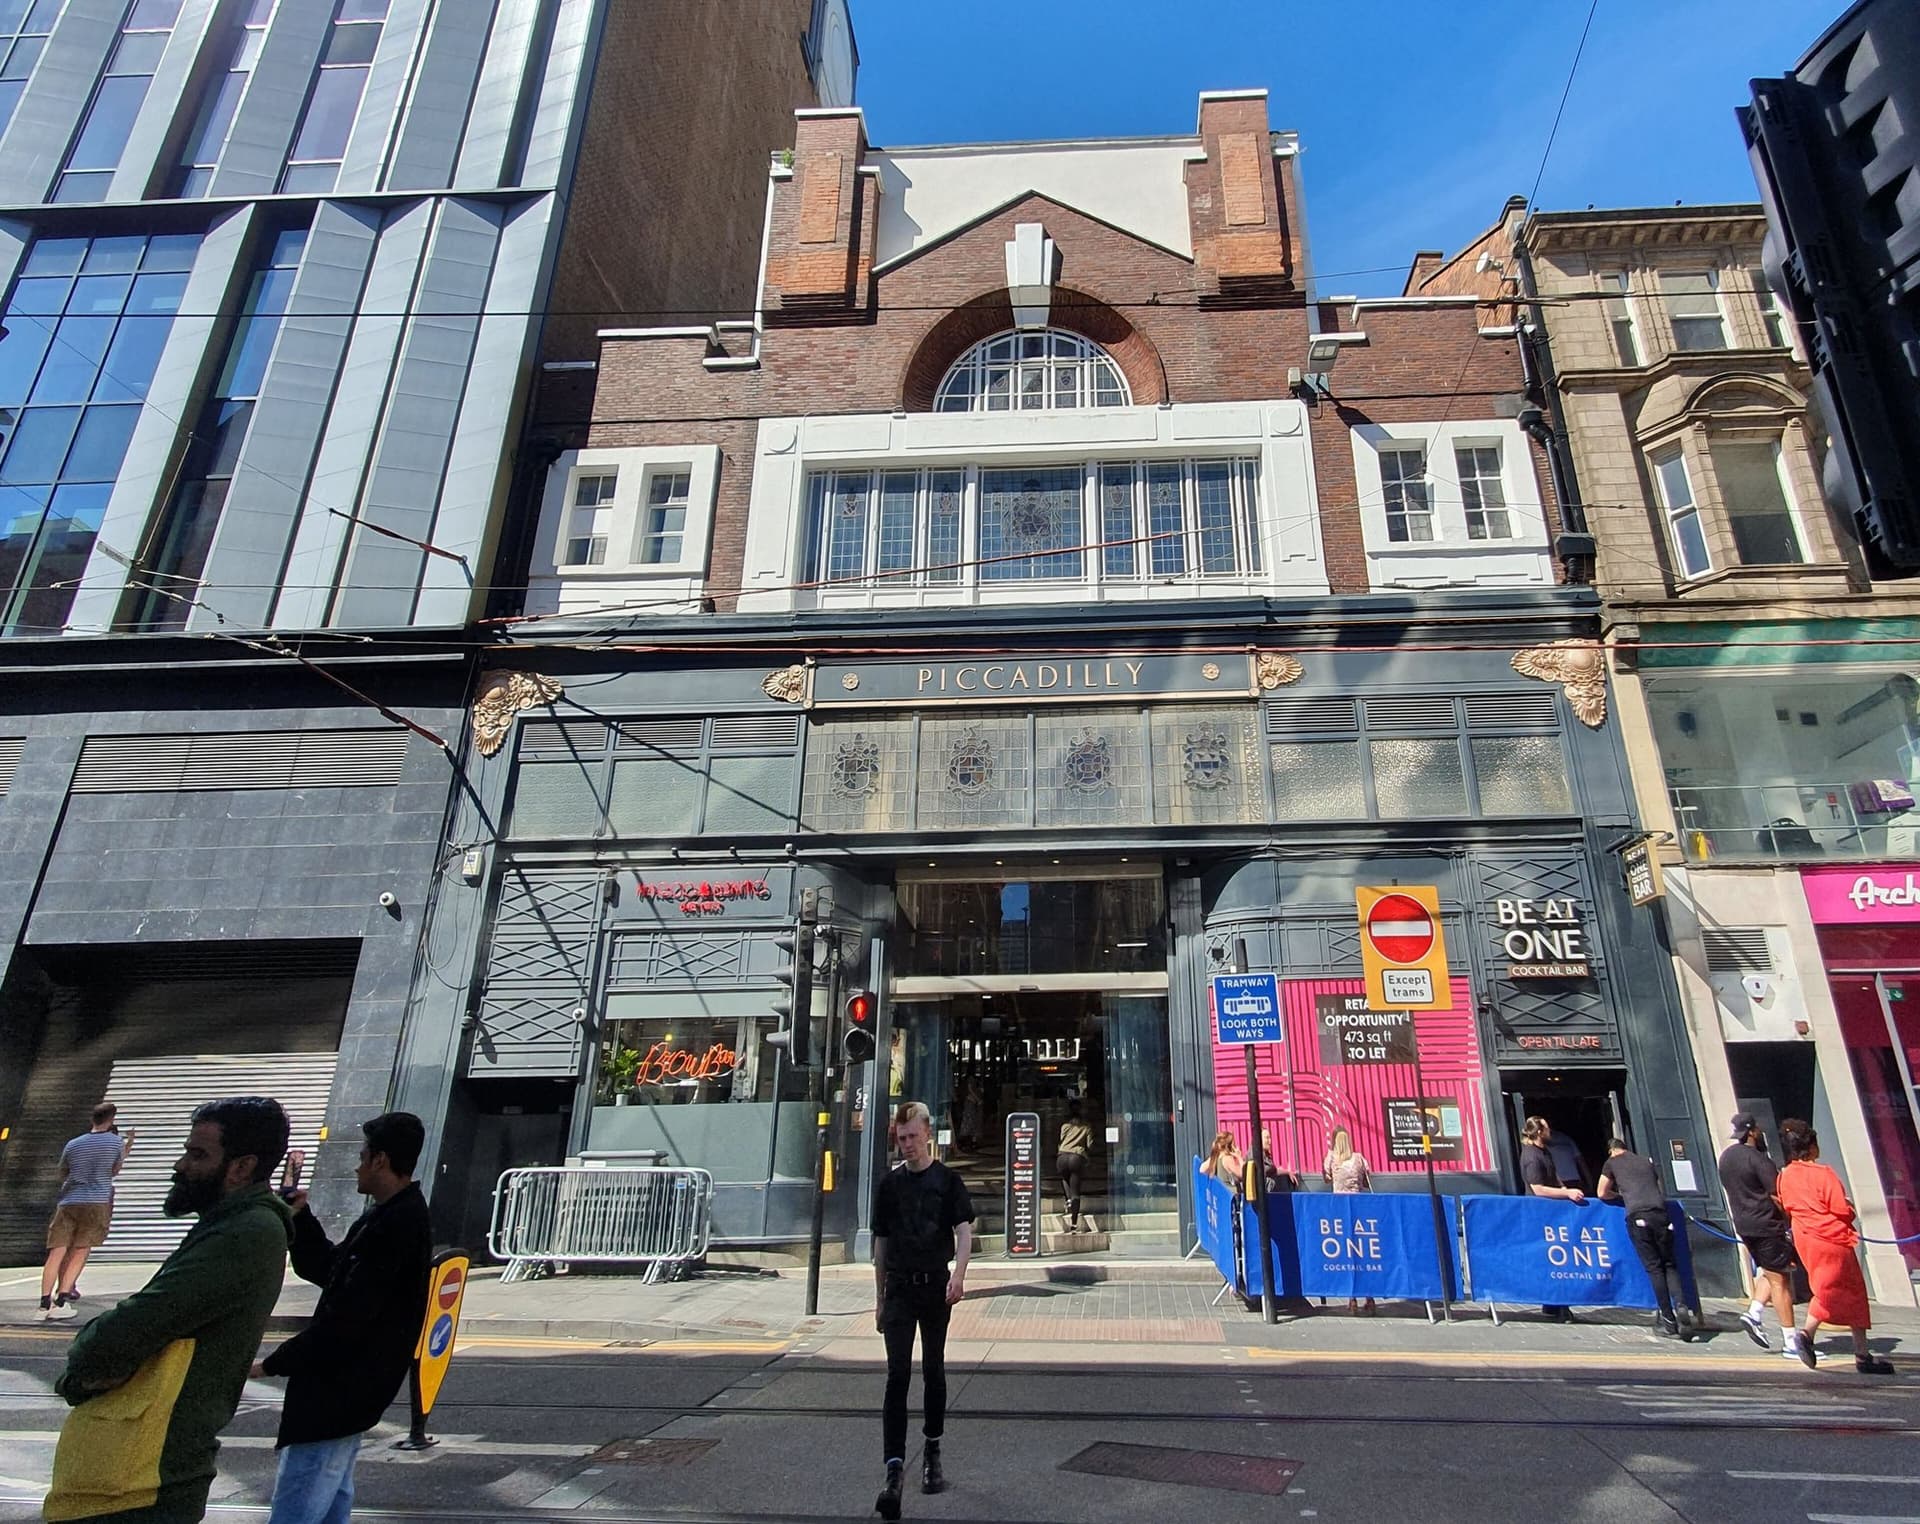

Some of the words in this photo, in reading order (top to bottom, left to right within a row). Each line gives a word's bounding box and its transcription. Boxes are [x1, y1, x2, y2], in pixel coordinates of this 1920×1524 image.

[917, 662, 1144, 691] PICCADILLY
[1633, 879, 1653, 900] BAR
[1497, 899, 1537, 923] BE
[1544, 898, 1577, 921] AT
[1504, 929, 1586, 960] ONE
[1511, 966, 1563, 976] COCKTAIL
[1565, 965, 1585, 975] BAR
[1221, 978, 1269, 989] TRAMWAY
[1388, 974, 1427, 986] Except
[1392, 988, 1425, 997] trams
[1345, 998, 1368, 1010] RETA
[1221, 1020, 1248, 1029] LOOK
[1250, 1018, 1277, 1028] BOTH
[1325, 1014, 1403, 1026] OPPORTUNITY
[1236, 1029, 1264, 1039] WAYS
[1344, 1031, 1364, 1043] 473
[1366, 1032, 1382, 1046] sq
[1383, 1030, 1392, 1042] ft
[1519, 1036, 1552, 1048] OPEN
[1571, 1035, 1600, 1047] LATE
[1349, 1047, 1366, 1059] TO
[1368, 1047, 1386, 1059] LET
[1394, 1114, 1419, 1125] Wright
[1320, 1218, 1343, 1234] BE
[1354, 1218, 1378, 1233] AT
[1544, 1226, 1569, 1242] BE
[1580, 1227, 1605, 1242] AT
[1321, 1237, 1381, 1258] ONE
[1547, 1244, 1612, 1267] ONE
[1323, 1263, 1364, 1272] COCKTAIL
[1366, 1263, 1383, 1272] BAR
[1550, 1271, 1593, 1280] COCKTAIL
